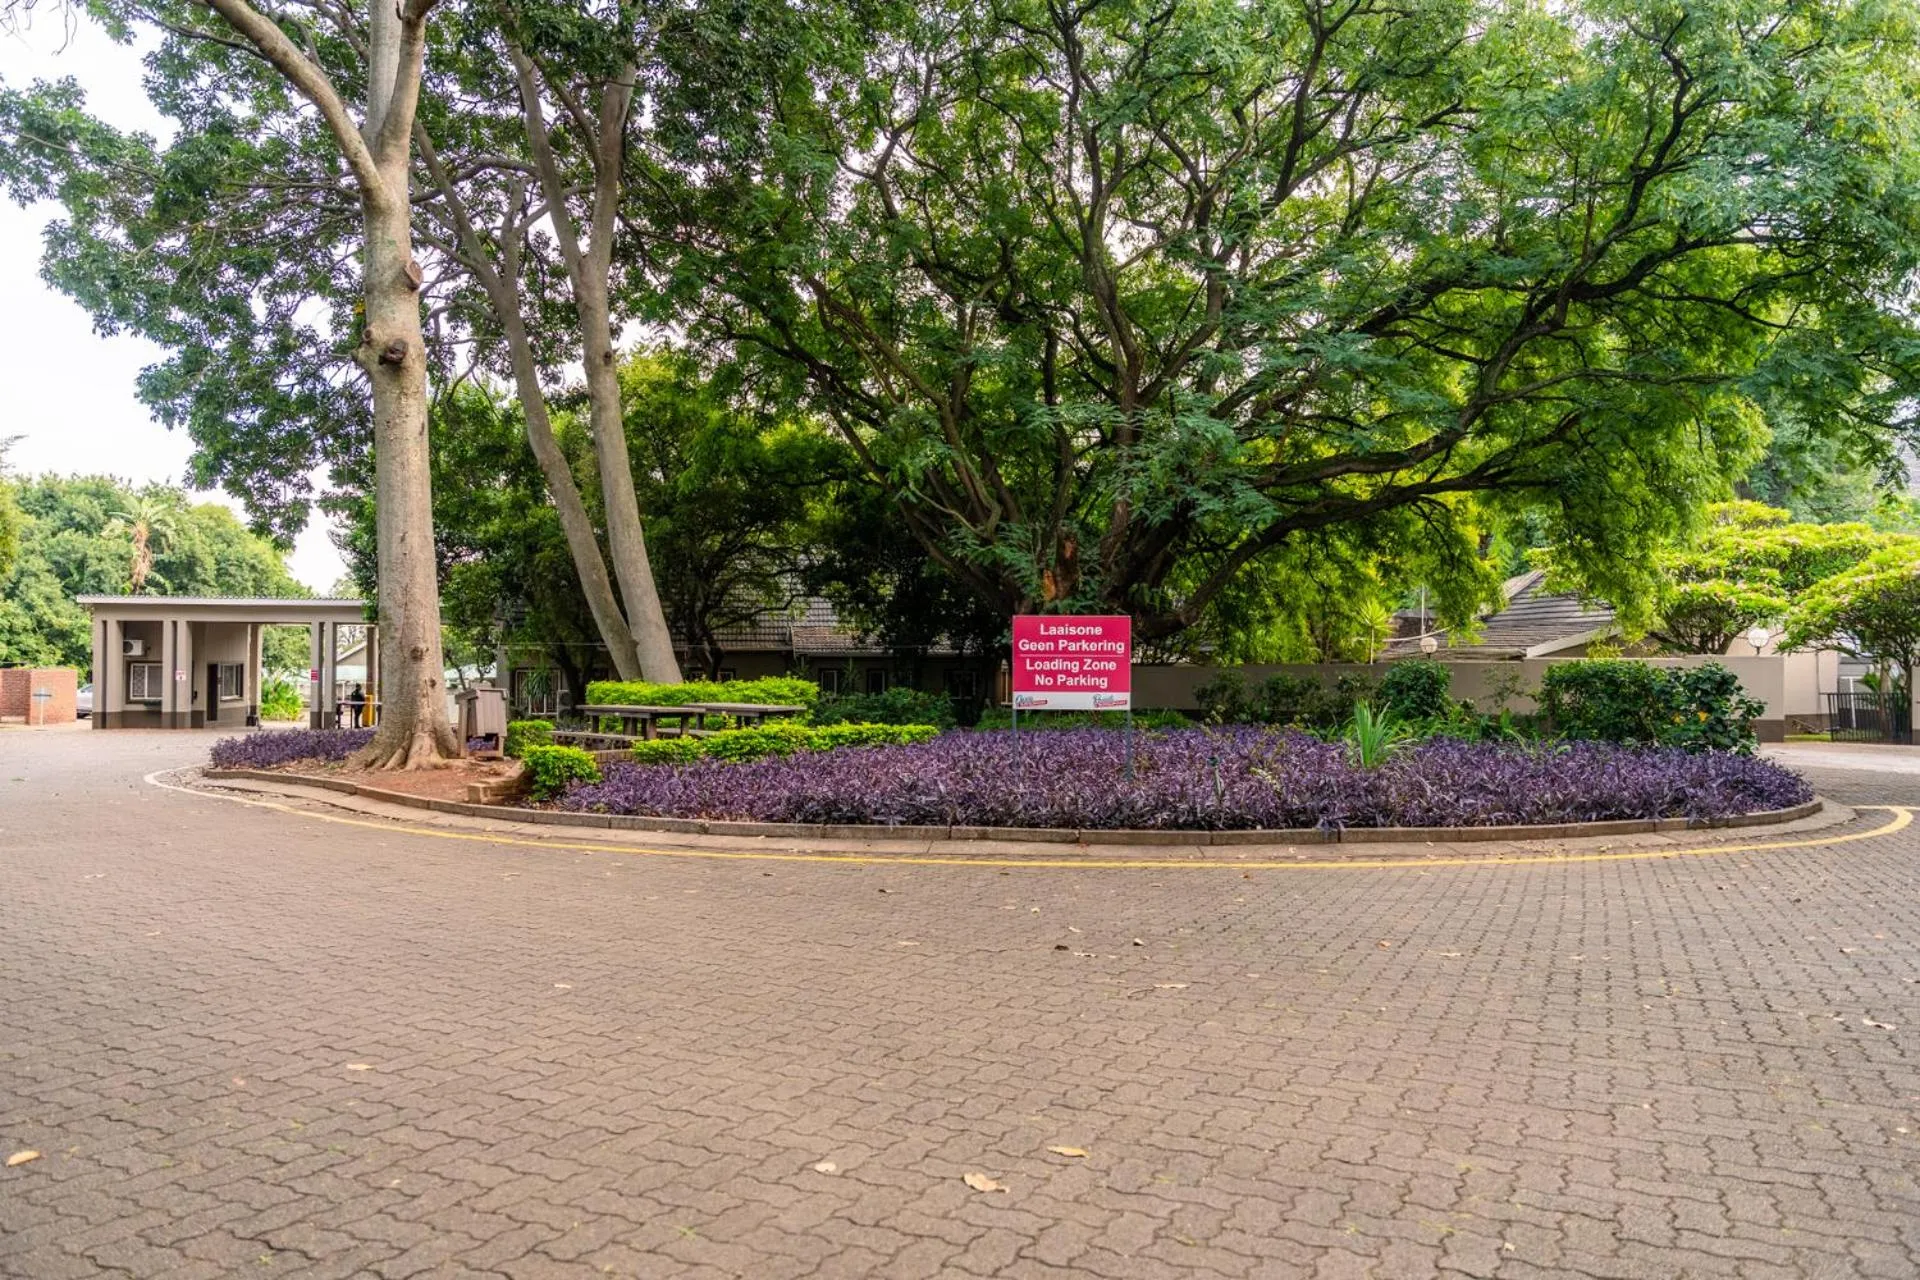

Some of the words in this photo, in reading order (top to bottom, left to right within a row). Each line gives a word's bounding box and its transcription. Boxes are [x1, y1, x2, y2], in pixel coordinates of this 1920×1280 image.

[1040, 624, 1103, 635] Laaisone
[1018, 639, 1054, 651] Geen
[1058, 639, 1125, 653] Parkering
[1026, 658, 1079, 672] Loading
[1083, 659, 1117, 671] Zone
[1035, 675, 1053, 686] No
[1057, 675, 1108, 688] Parking
